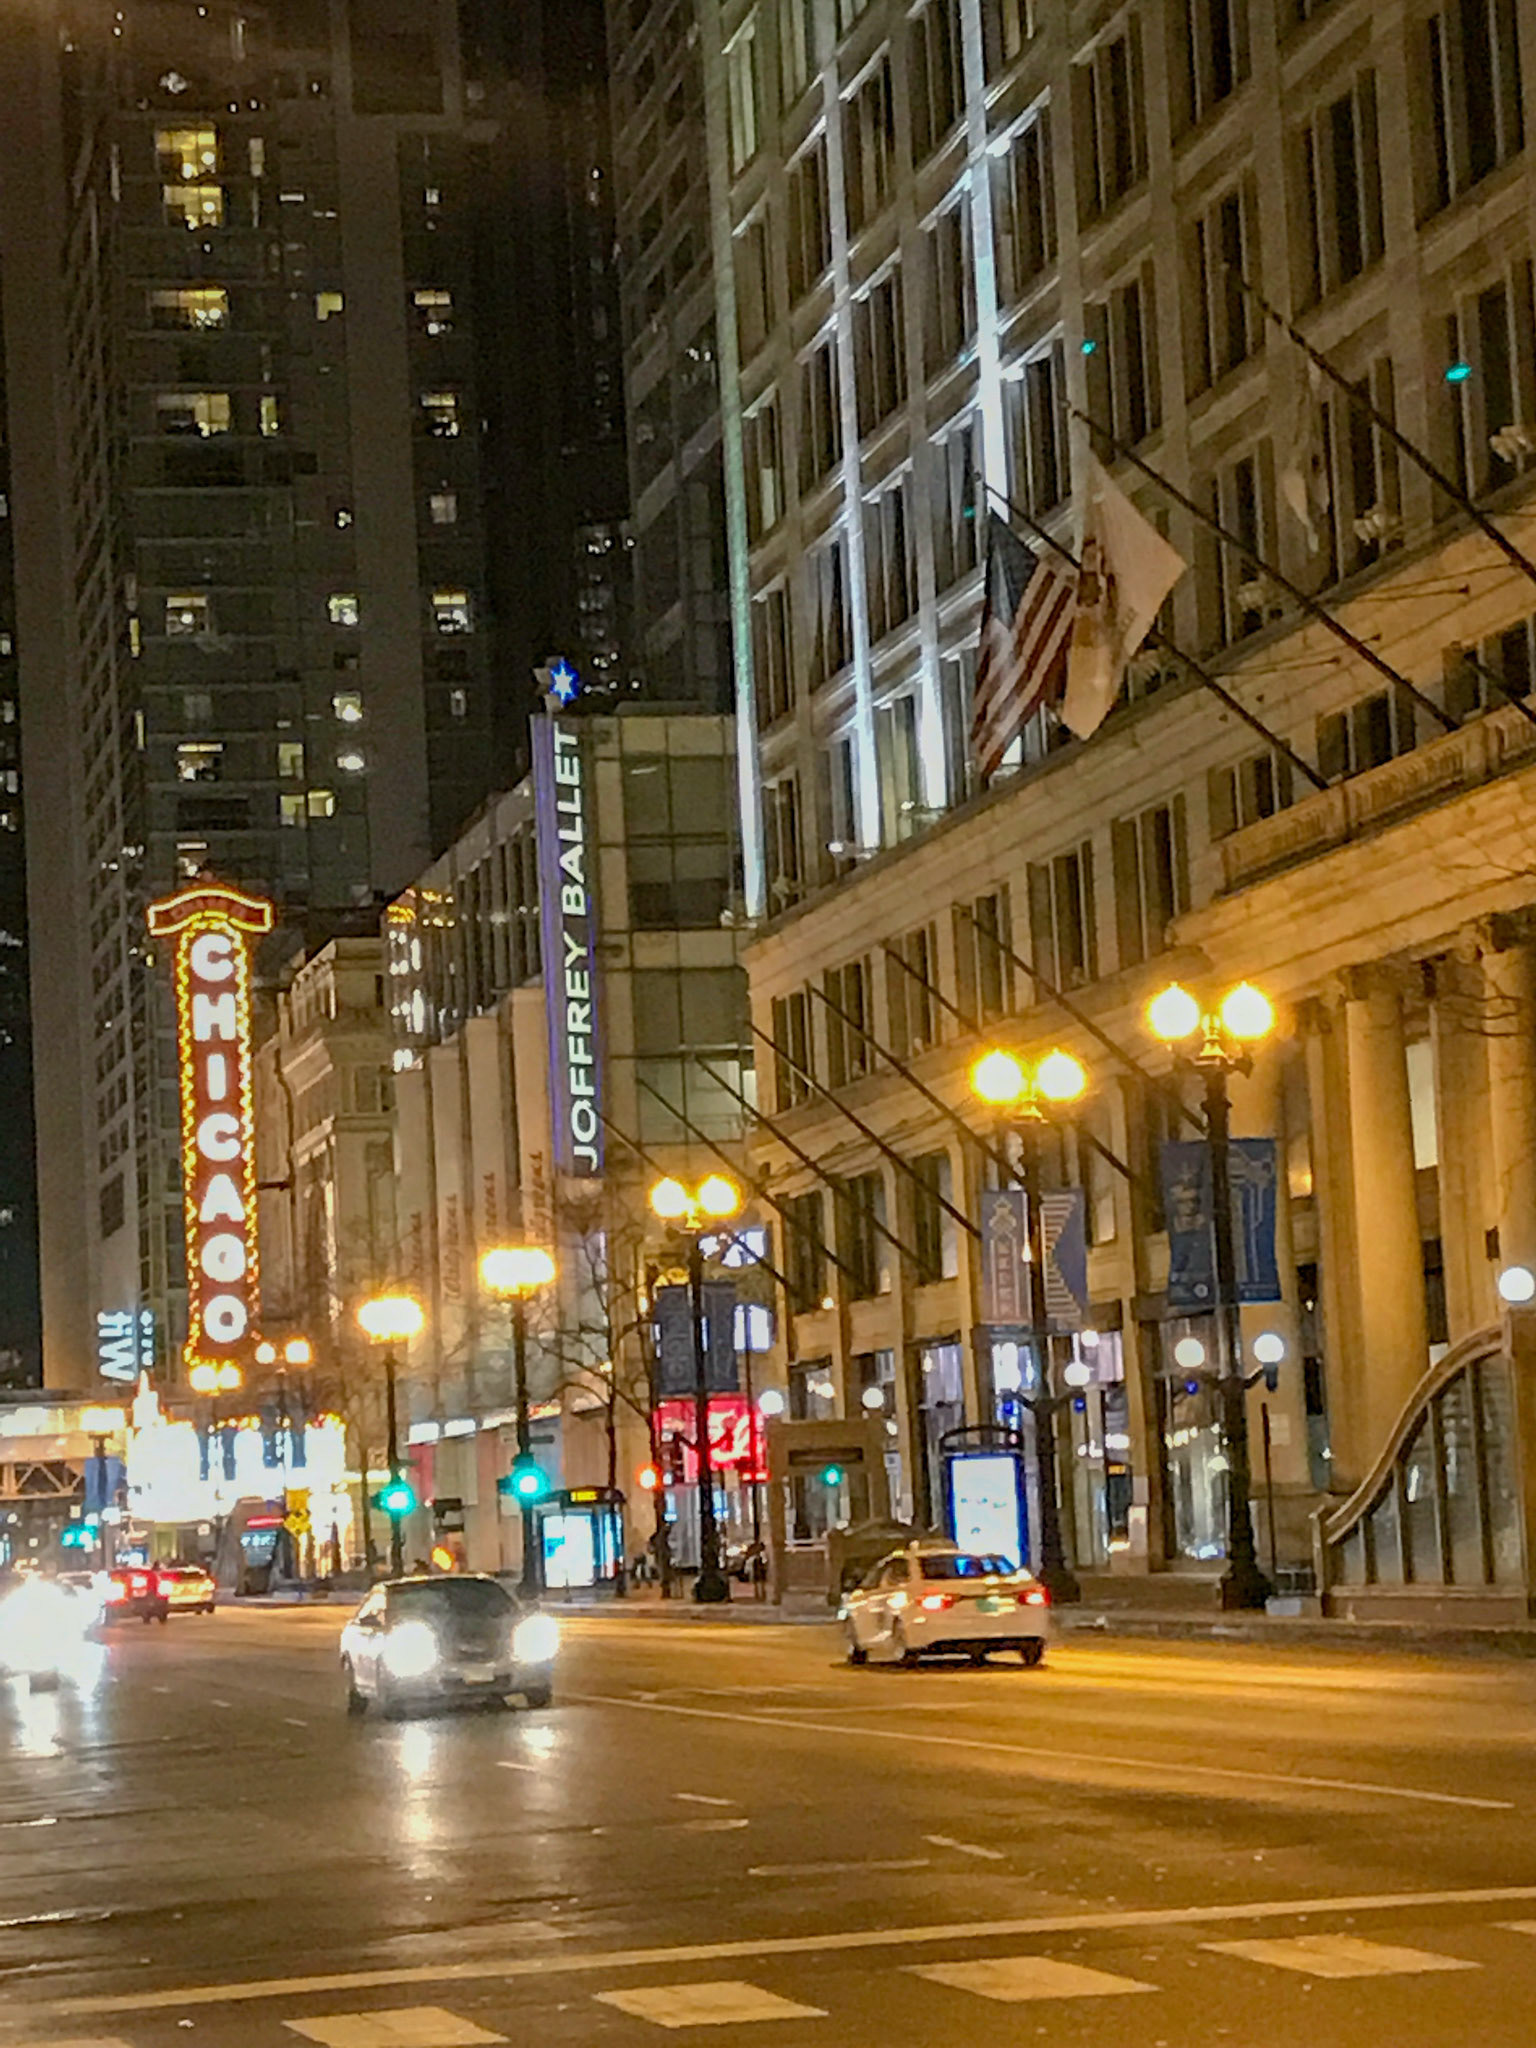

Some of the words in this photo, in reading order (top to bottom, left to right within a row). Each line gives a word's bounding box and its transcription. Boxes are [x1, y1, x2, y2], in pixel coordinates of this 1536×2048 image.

[554, 721, 587, 917] BALLET
[190, 933, 248, 1344] CHICAGO
[563, 931, 598, 1171] JOFFREY
